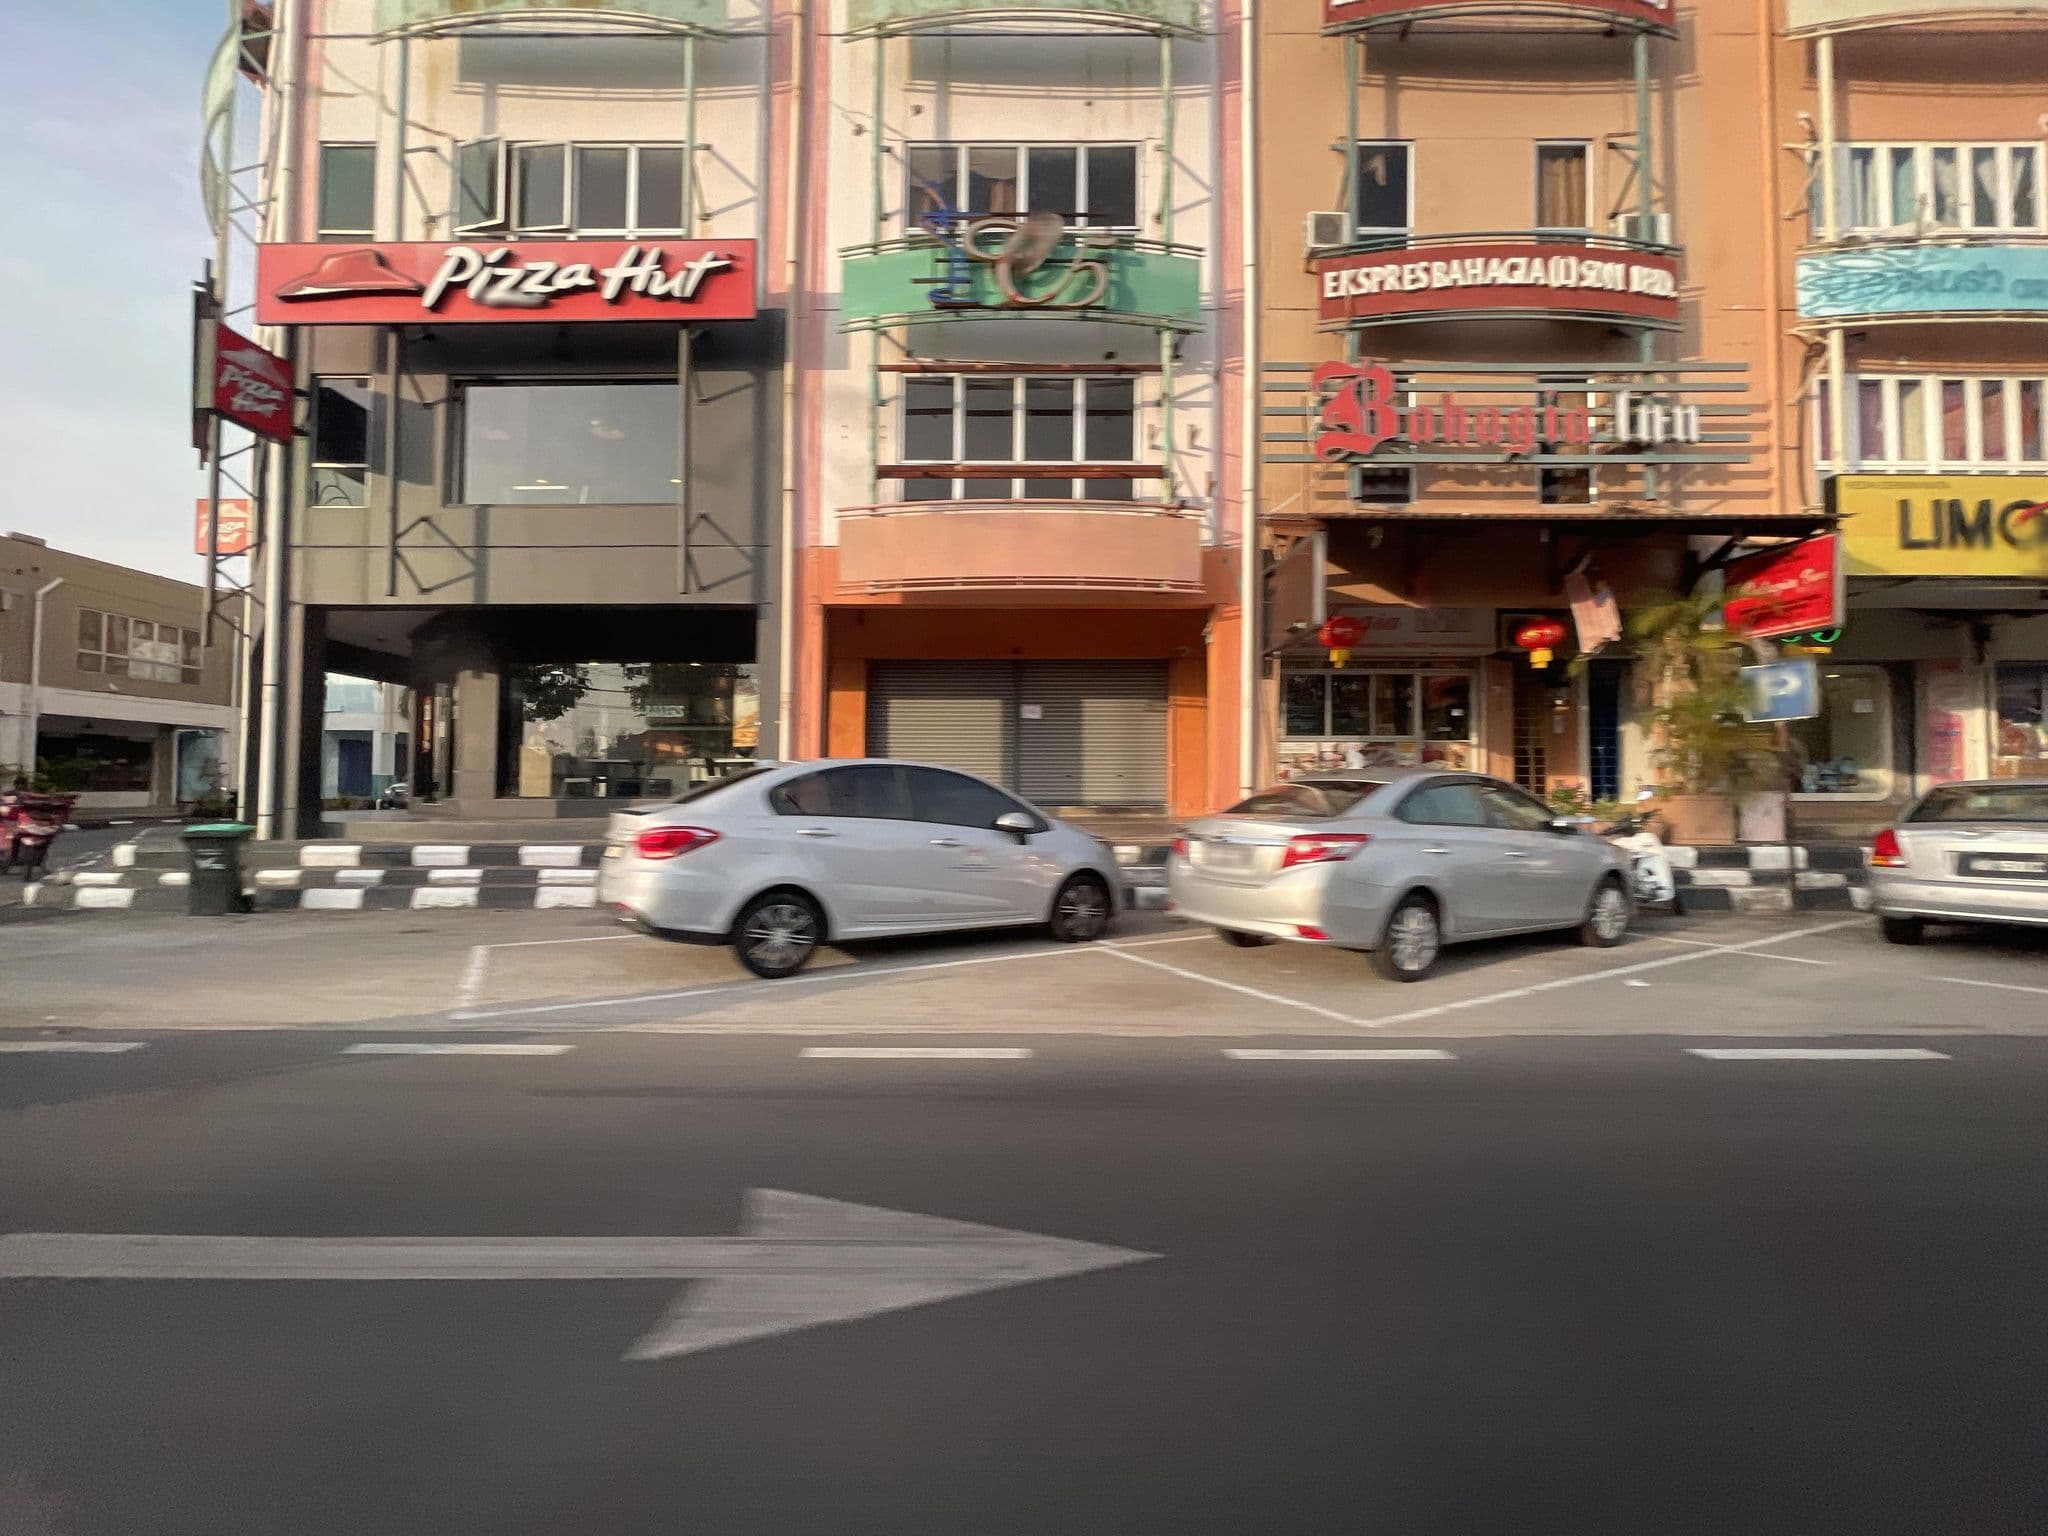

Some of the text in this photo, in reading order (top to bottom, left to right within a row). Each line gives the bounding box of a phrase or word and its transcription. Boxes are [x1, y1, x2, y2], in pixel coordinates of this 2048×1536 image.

[421, 245, 733, 307] Pizza Hut
[1323, 262, 1430, 298] EKSPRES
[1431, 257, 1545, 288] BAHAGIA
[1313, 359, 1698, 461] Bahagia Inn
[1757, 671, 1801, 713] P
